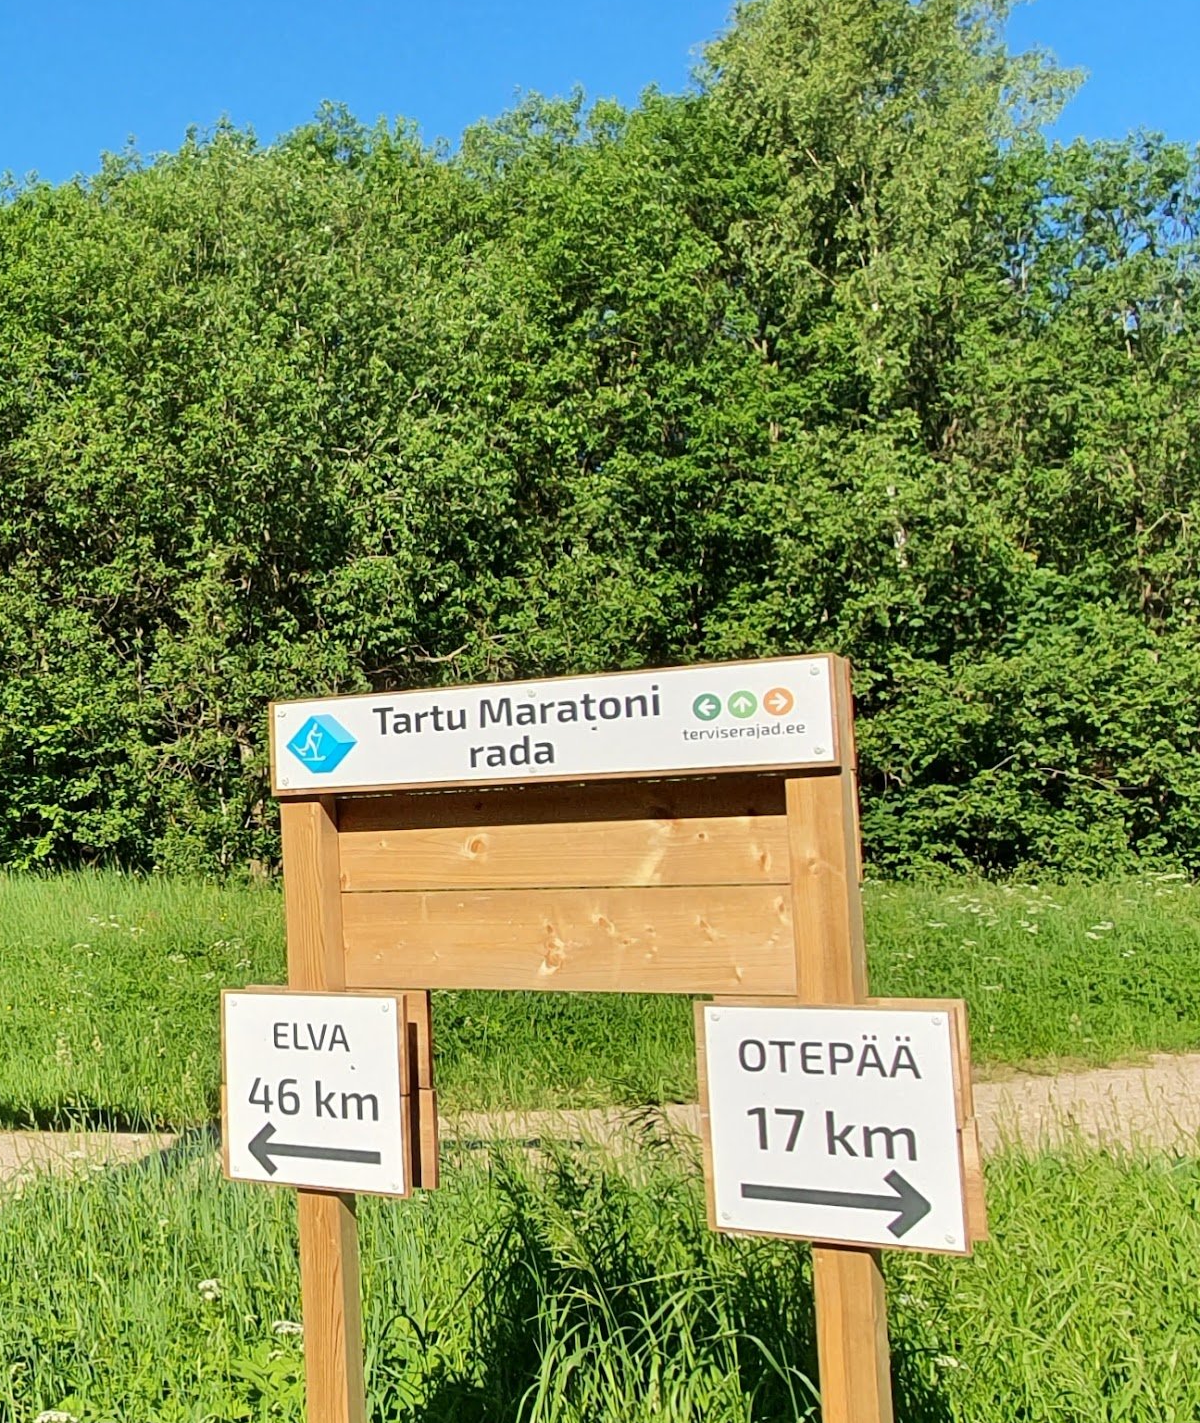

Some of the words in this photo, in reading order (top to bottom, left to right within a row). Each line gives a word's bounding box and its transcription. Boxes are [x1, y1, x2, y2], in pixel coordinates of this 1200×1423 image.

[373, 704, 468, 735] Tartu
[479, 684, 662, 726] Maratoni
[682, 722, 806, 741] terviserajad.ee
[469, 735, 555, 768] rada
[273, 1022, 351, 1052] ELVA
[738, 1034, 922, 1079] OTEPÄÄ
[248, 1077, 301, 1116] 46
[315, 1080, 379, 1121] km
[747, 1107, 805, 1152] 17
[825, 1110, 917, 1161] km
